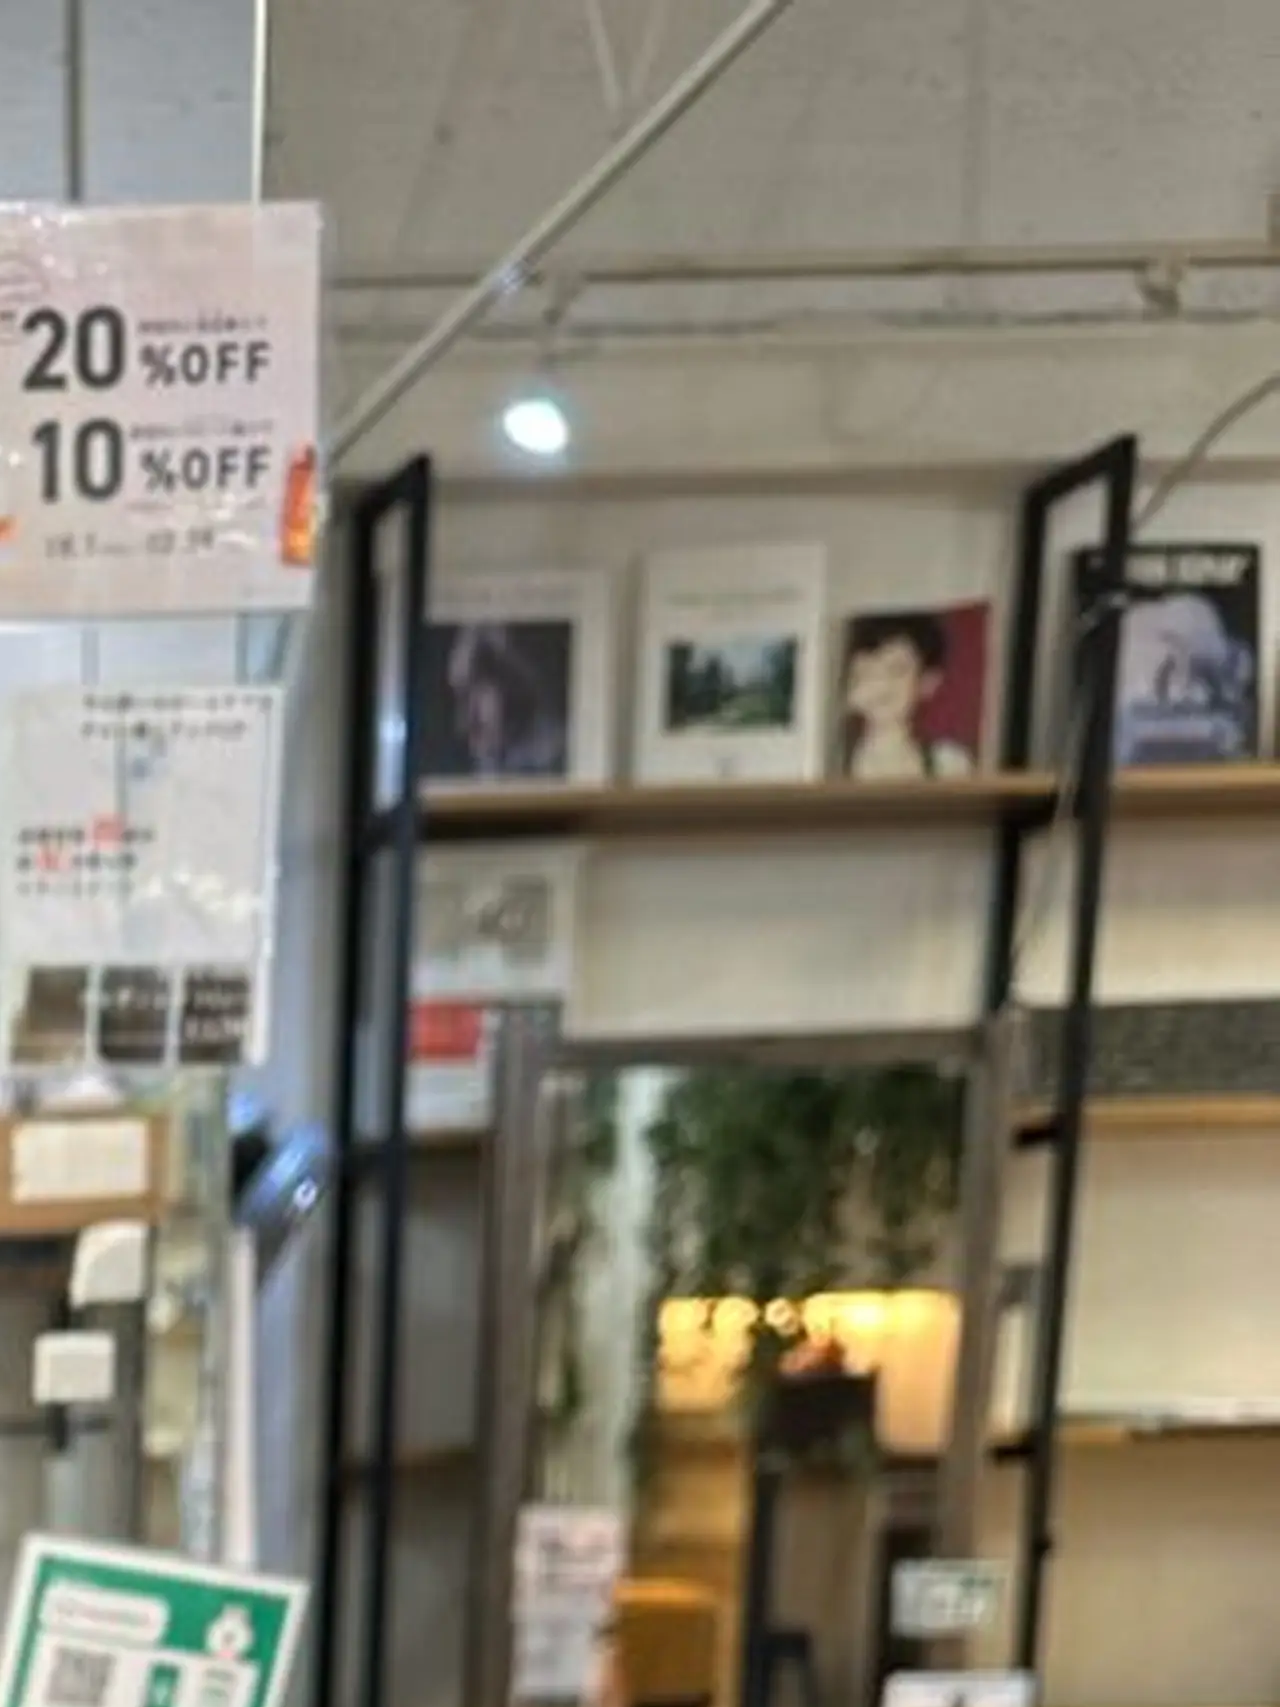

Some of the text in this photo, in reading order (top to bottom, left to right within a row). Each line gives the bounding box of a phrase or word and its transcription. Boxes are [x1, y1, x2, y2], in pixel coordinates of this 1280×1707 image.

[22, 306, 126, 392] 20
[141, 341, 272, 387] %OFF
[33, 418, 272, 503] 10 %OFF
